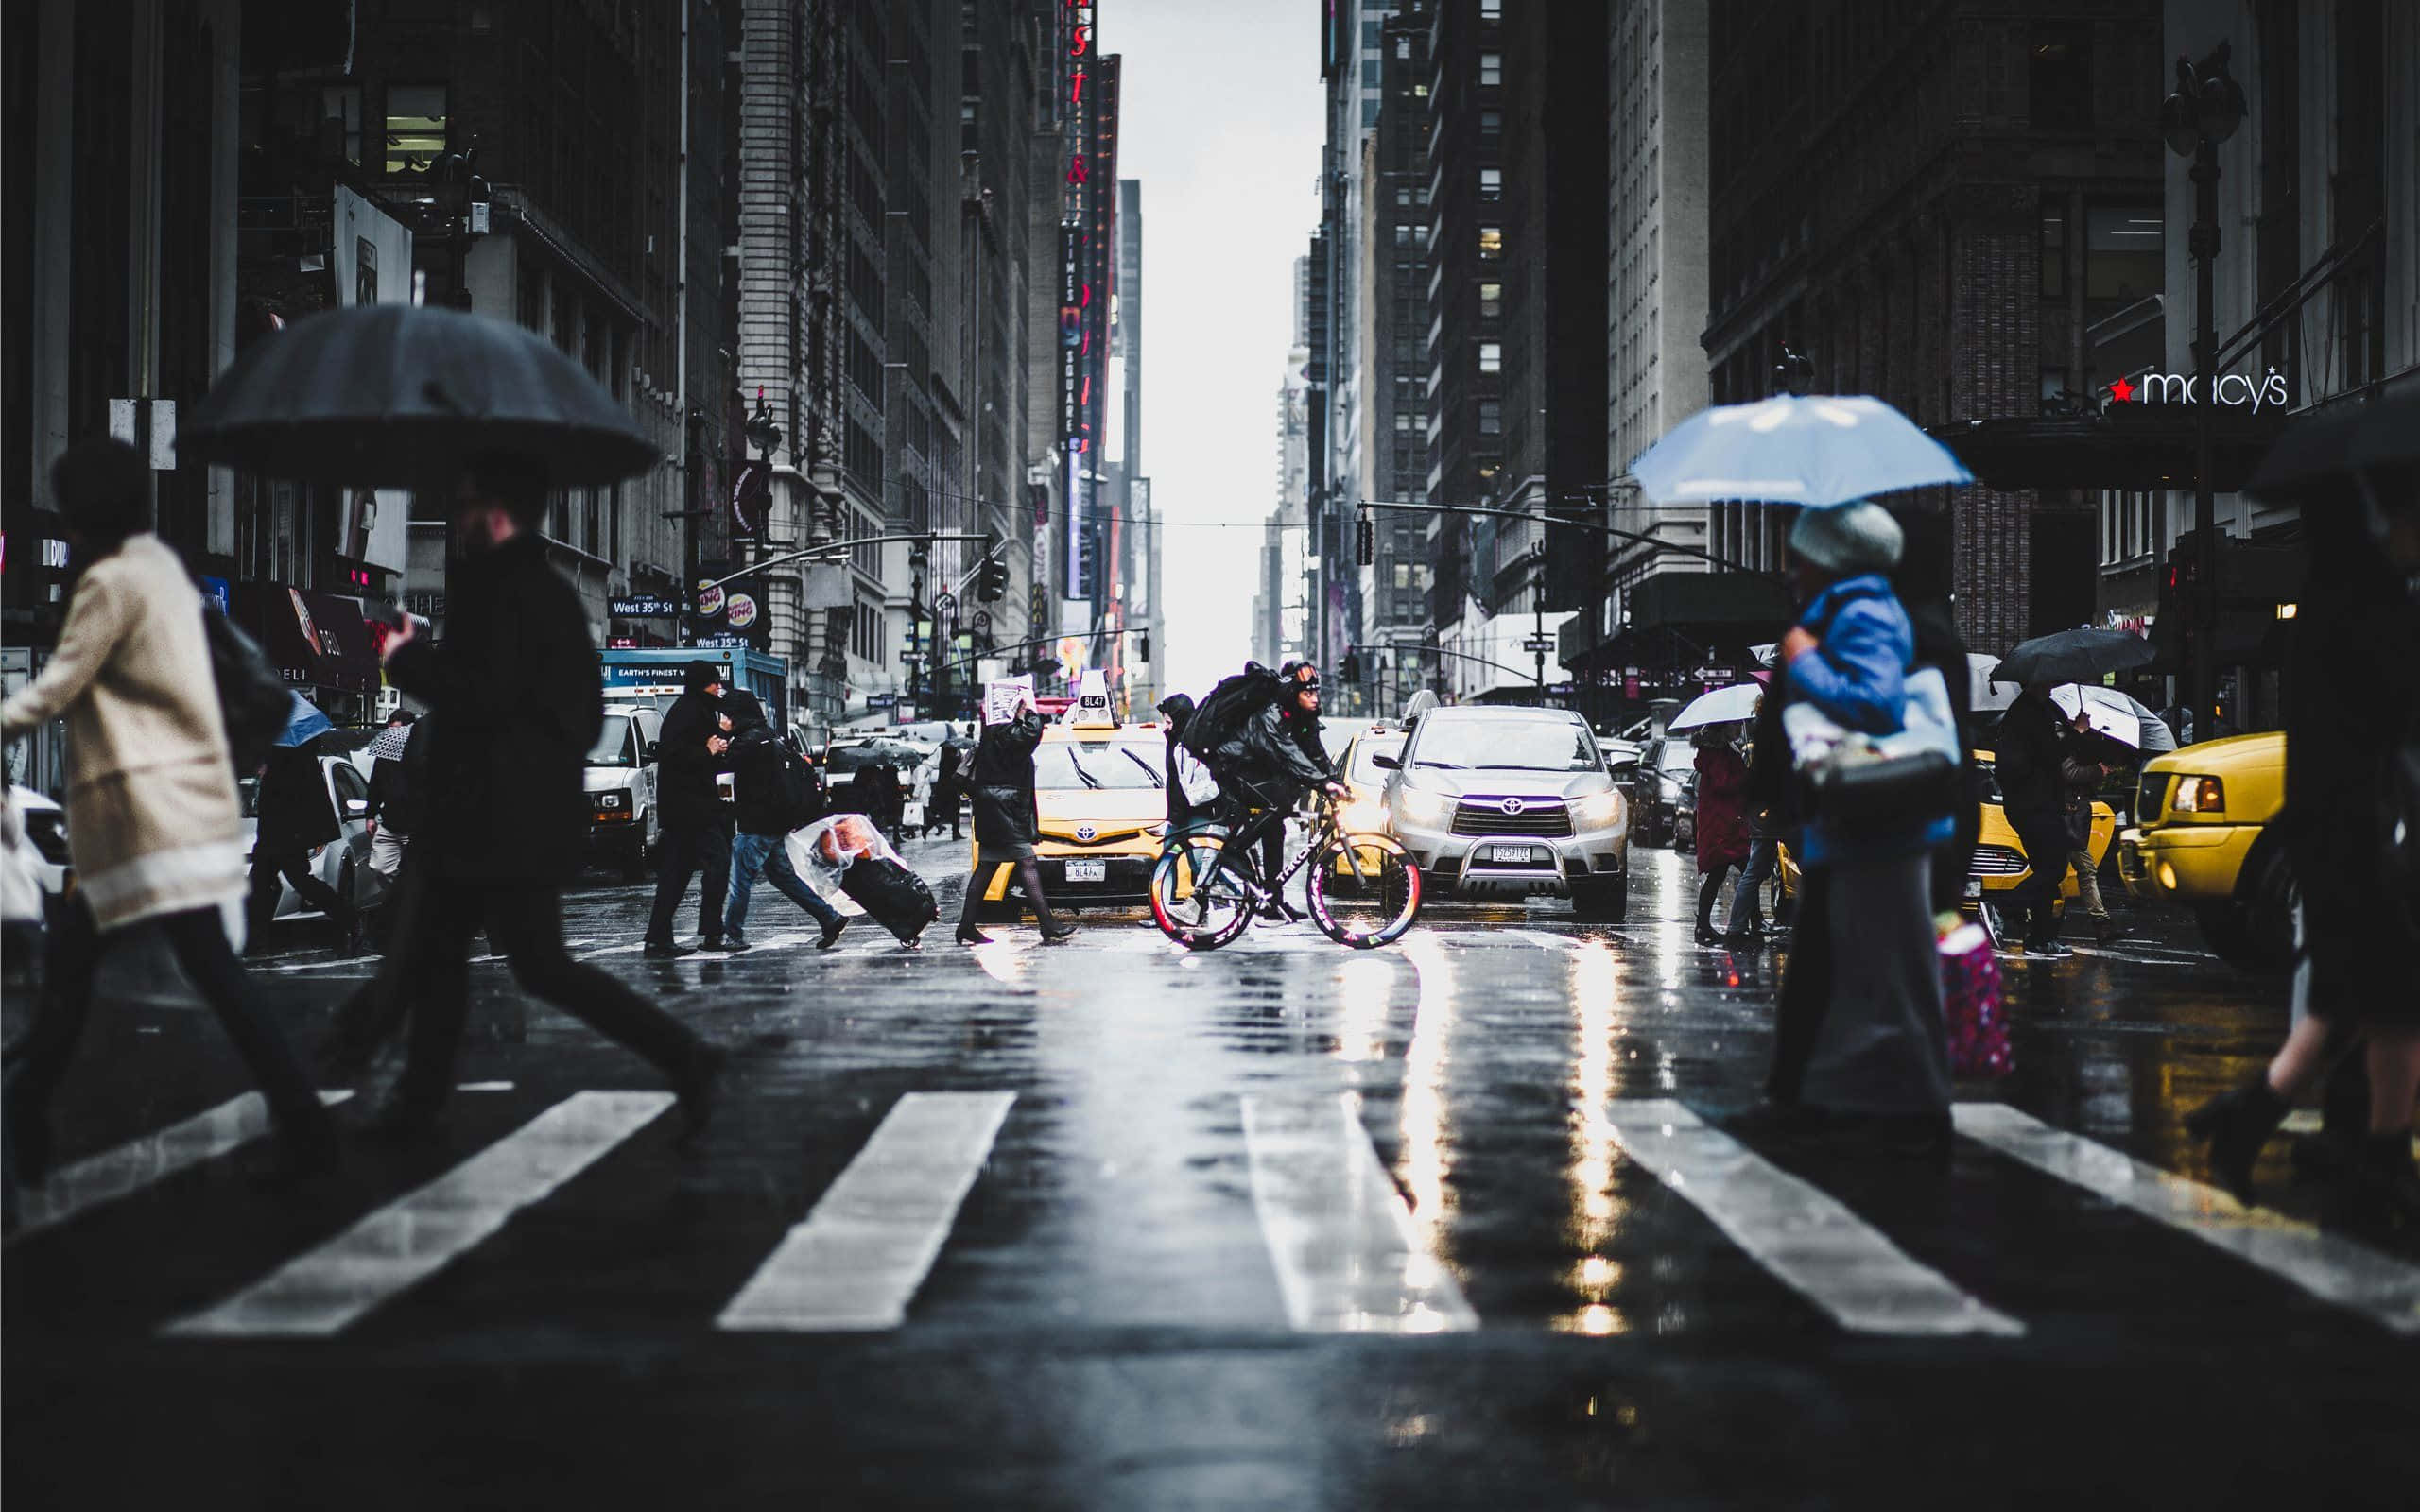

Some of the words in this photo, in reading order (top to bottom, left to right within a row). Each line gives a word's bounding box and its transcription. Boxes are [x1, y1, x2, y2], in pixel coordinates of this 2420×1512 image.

[614, 602, 639, 613] West
[642, 602, 661, 613] 35th
[663, 602, 673, 613] St
[696, 637, 718, 648] West
[720, 637, 737, 648] 35th
[738, 637, 749, 648] St
[276, 668, 306, 680] ELI
[618, 668, 650, 678] EARTH'S
[651, 668, 678, 678] FINEST
[1084, 696, 1104, 707] 8L47
